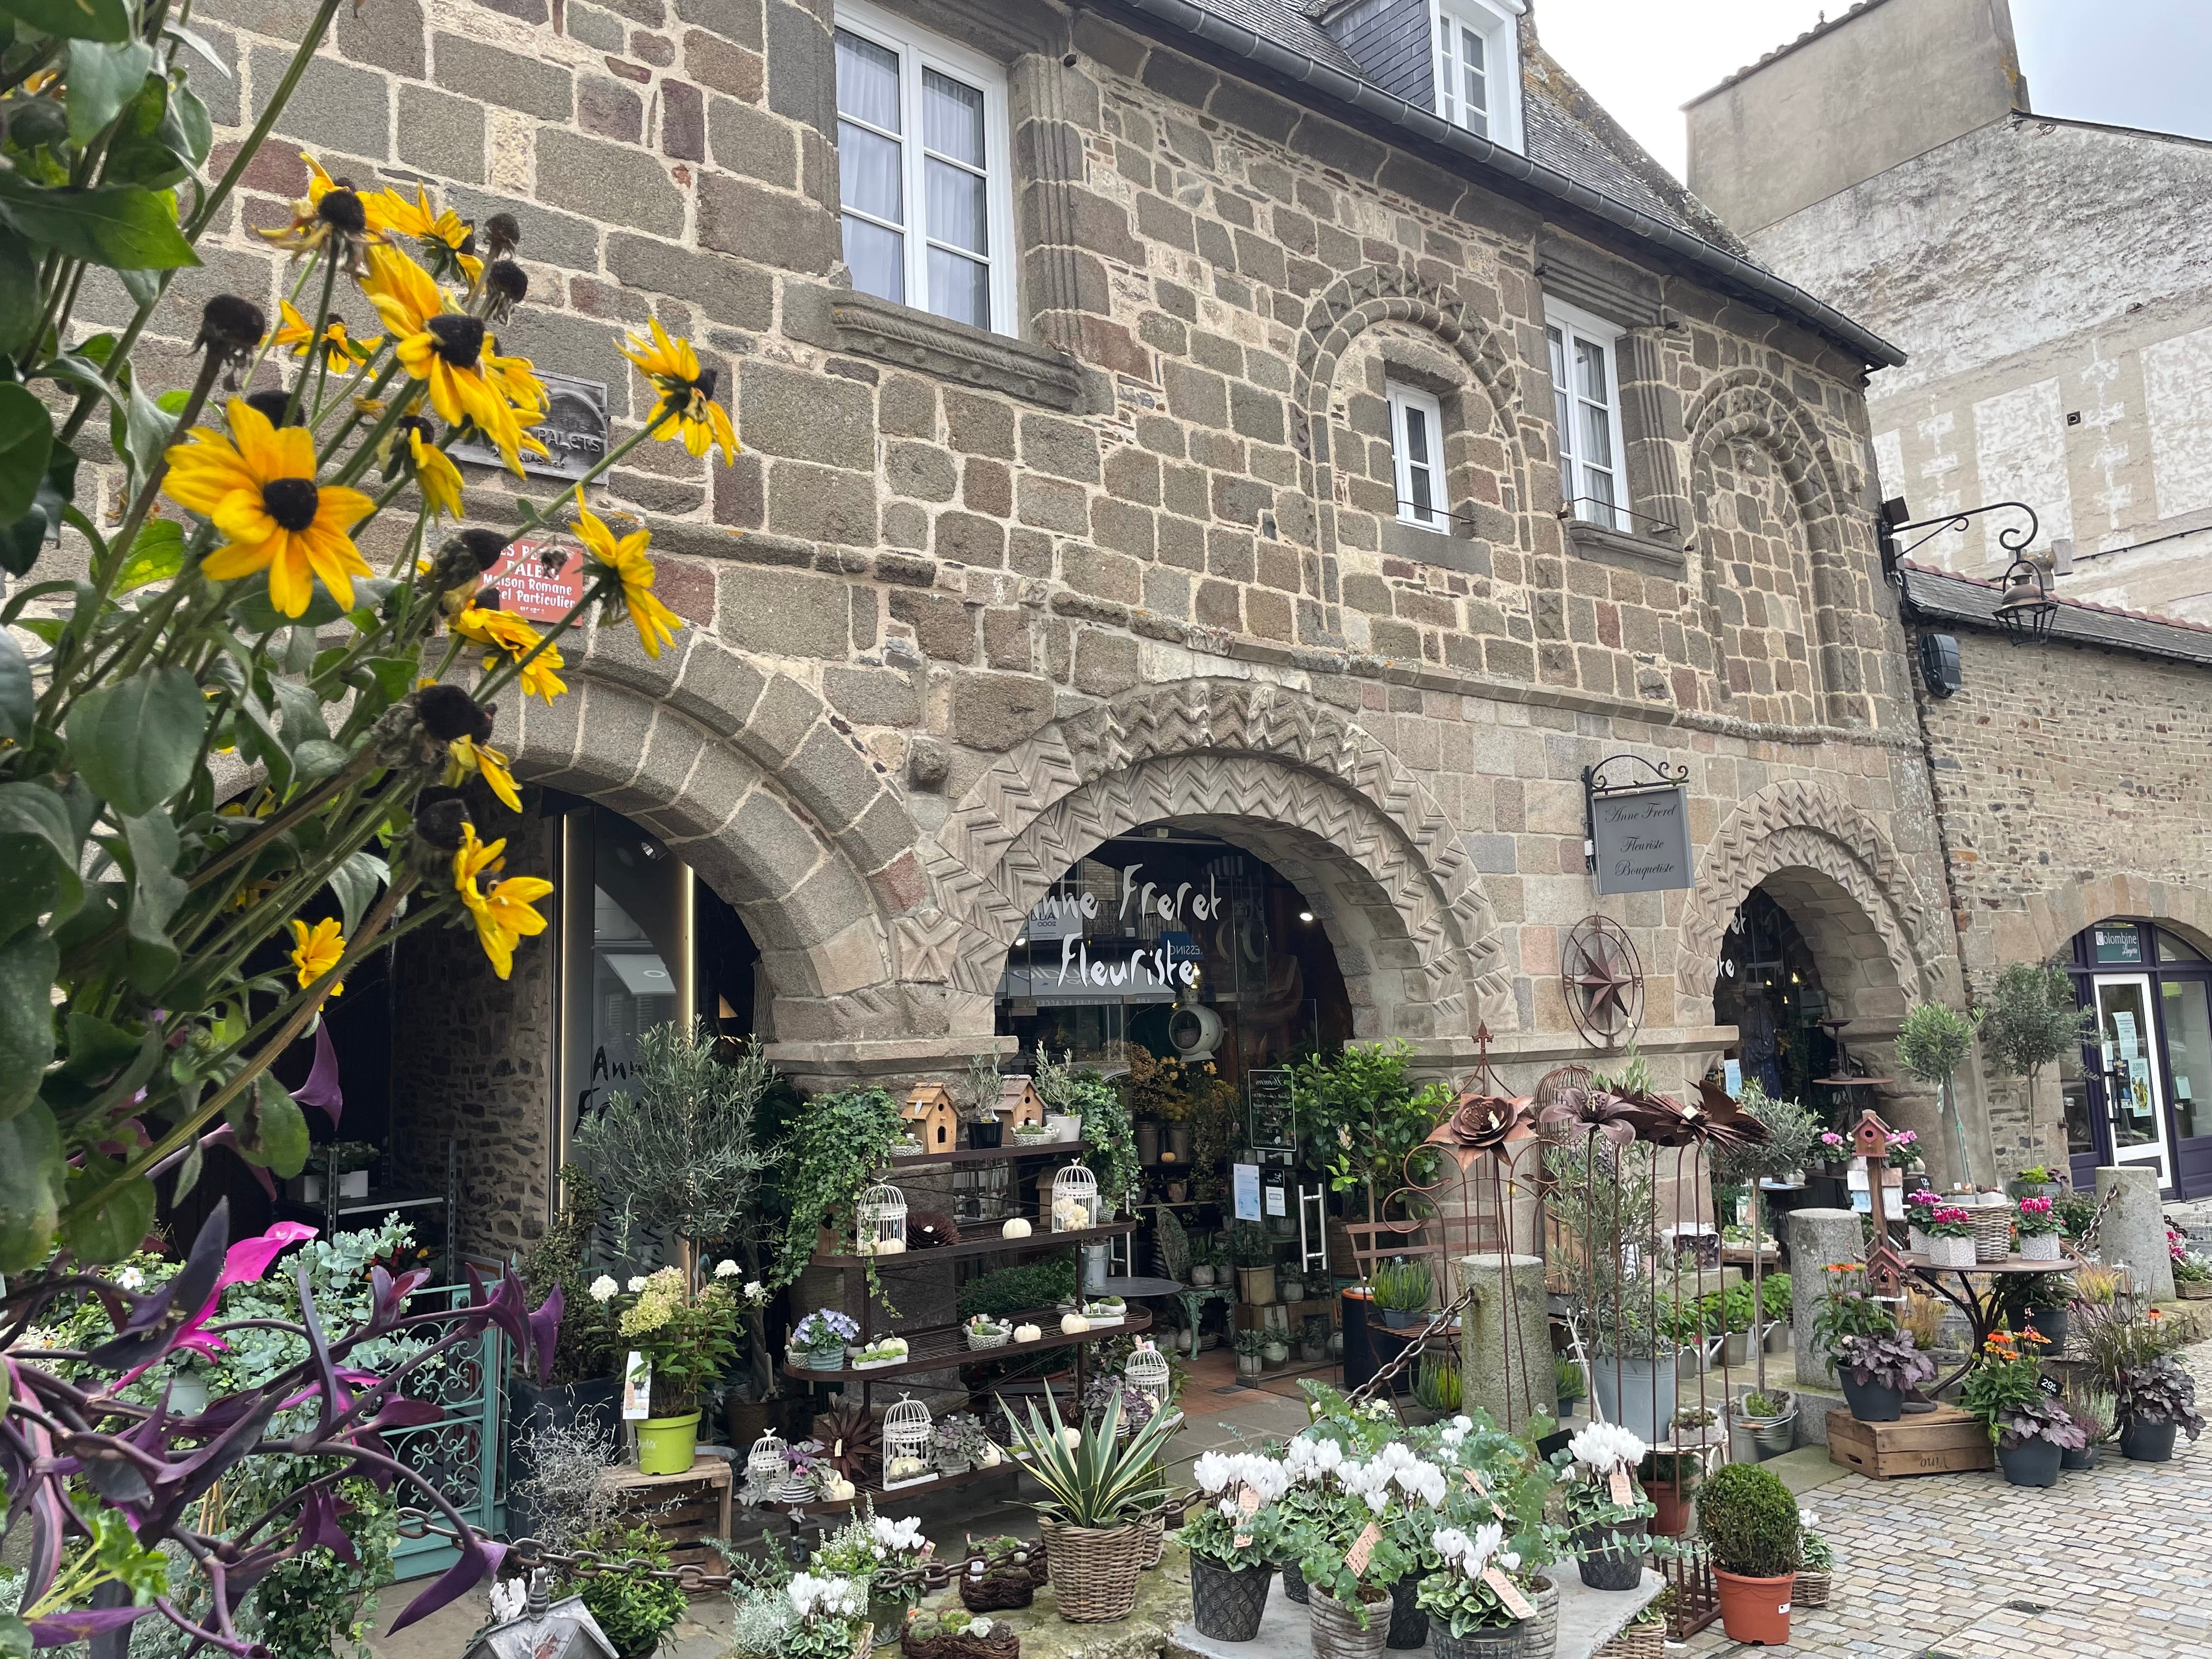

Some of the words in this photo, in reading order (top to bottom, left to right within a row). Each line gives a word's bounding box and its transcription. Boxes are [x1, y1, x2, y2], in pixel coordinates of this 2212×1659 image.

[537, 428, 601, 453] PALETS
[528, 579, 572, 596] Romane
[516, 590, 575, 609] Particulier
[1620, 836, 1664, 853] Fleuriste
[1615, 860, 1675, 881] Bouquetiste
[1030, 891, 1099, 921] nne
[1119, 864, 1222, 922] Freret
[2096, 932, 2137, 945] Colombine
[1057, 932, 1195, 988] Fleuriste
[593, 1046, 643, 1081] Ann
[1920, 1457, 1950, 1469] Vino
